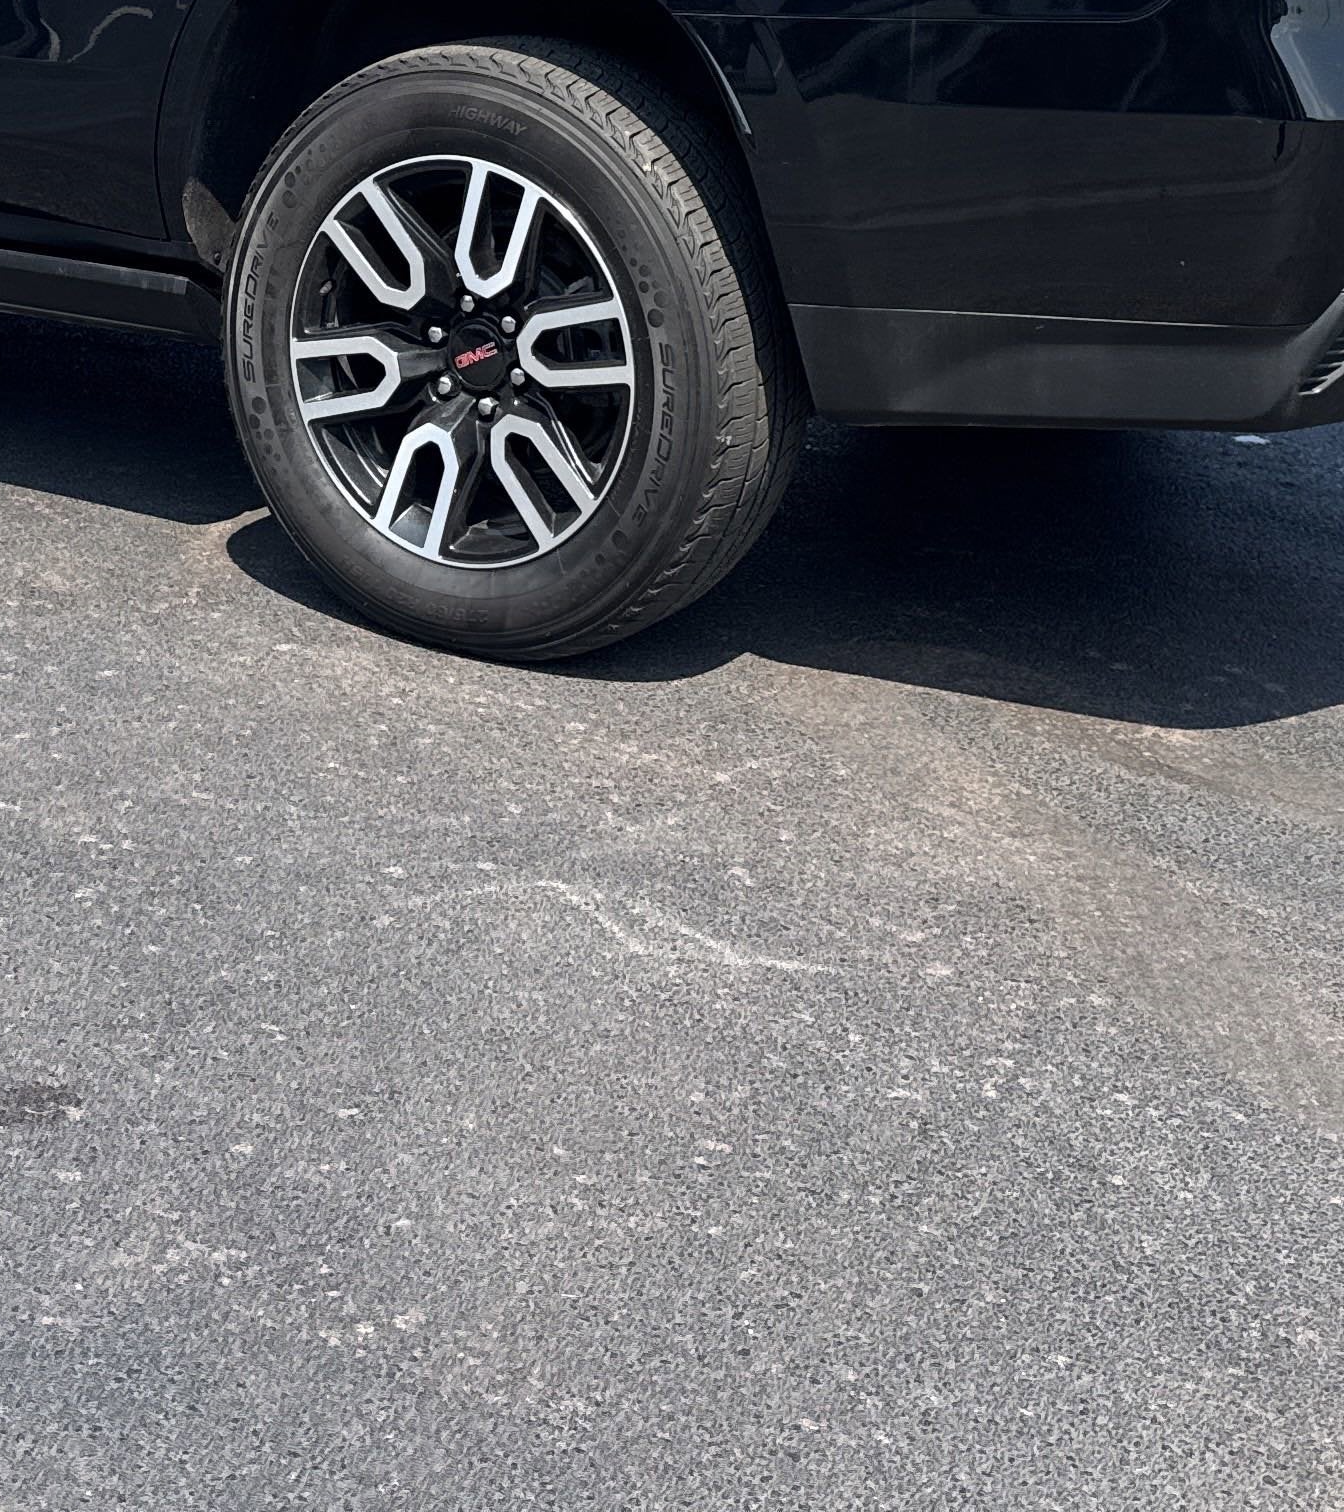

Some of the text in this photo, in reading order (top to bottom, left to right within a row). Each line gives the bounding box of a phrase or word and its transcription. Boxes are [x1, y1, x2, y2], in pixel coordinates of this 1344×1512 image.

[242, 211, 279, 384] SUREDRIVE
[454, 341, 498, 369] GMC
[632, 342, 676, 528] SUREDRIVE
